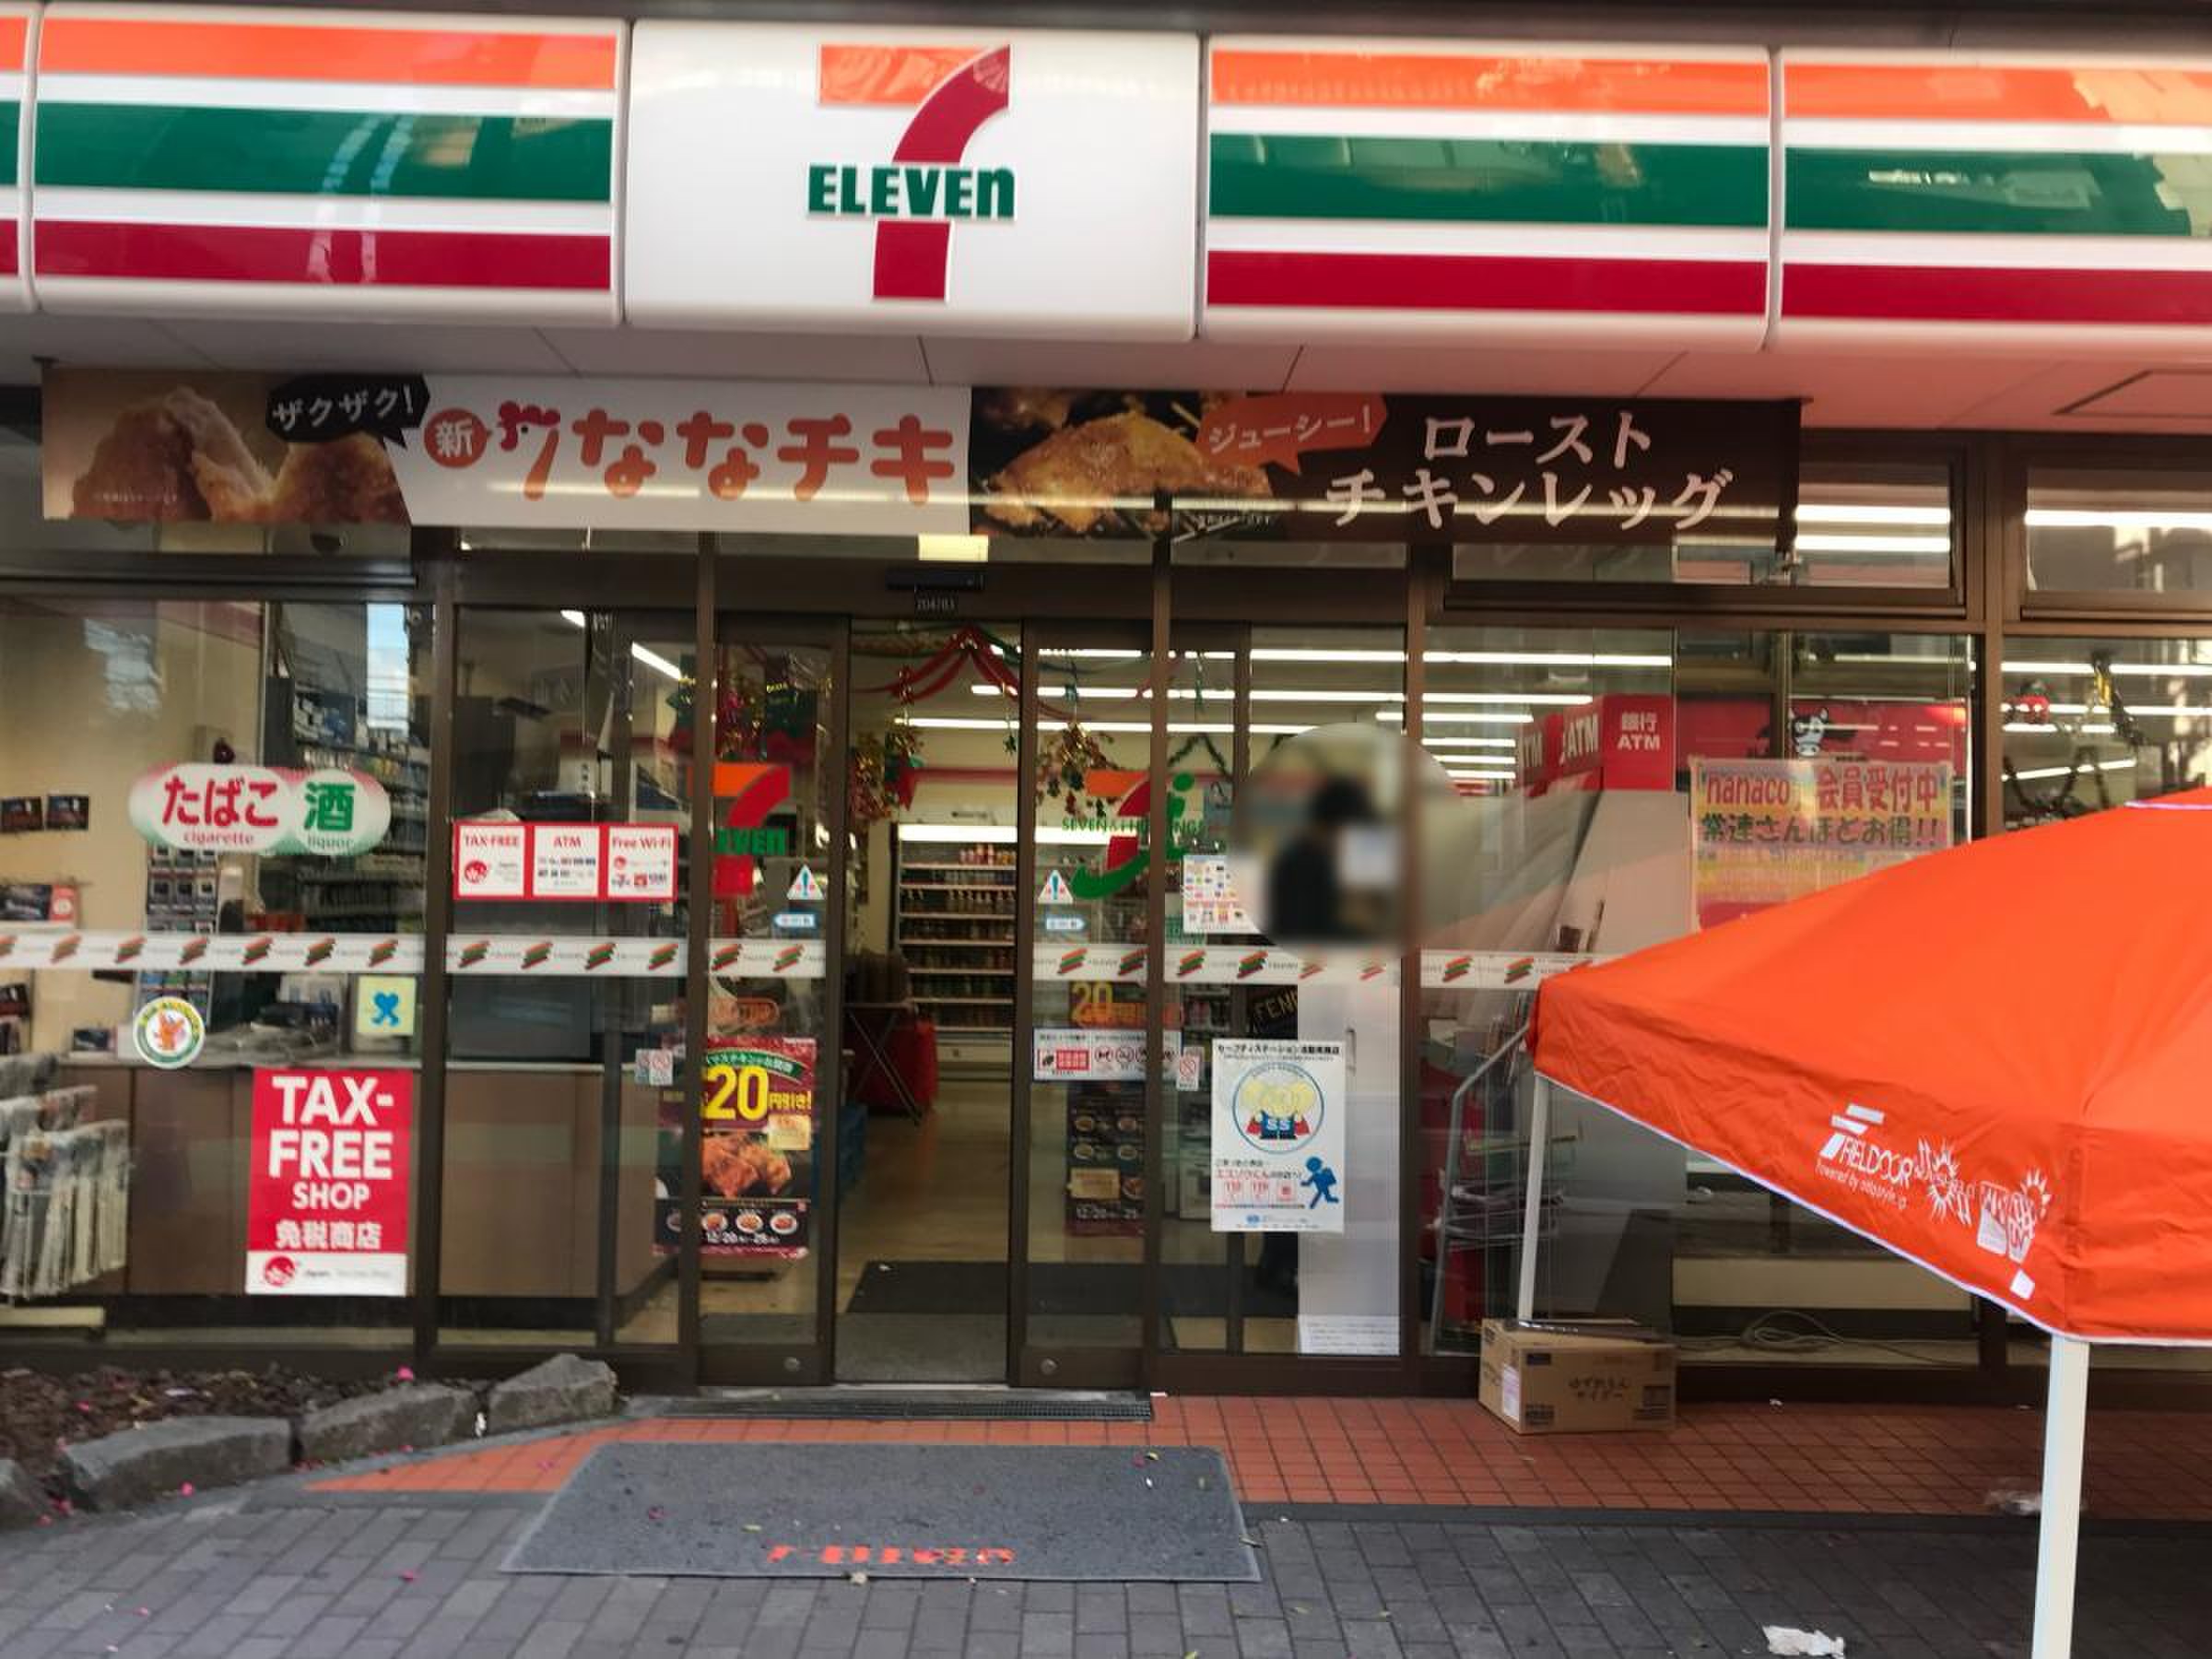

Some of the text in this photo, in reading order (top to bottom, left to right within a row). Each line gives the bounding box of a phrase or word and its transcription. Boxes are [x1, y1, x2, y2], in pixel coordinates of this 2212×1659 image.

[435, 427, 474, 456] 新
[1423, 411, 1651, 467] ロースト
[1324, 468, 1735, 531] チキンレッグ
[1617, 734, 1661, 750] ATM
[161, 776, 278, 828] たばこ
[304, 781, 356, 831] 酒
[272, 1077, 394, 1124] TAX-
[268, 1130, 394, 1179] FREE
[292, 1182, 370, 1209] SHOP
